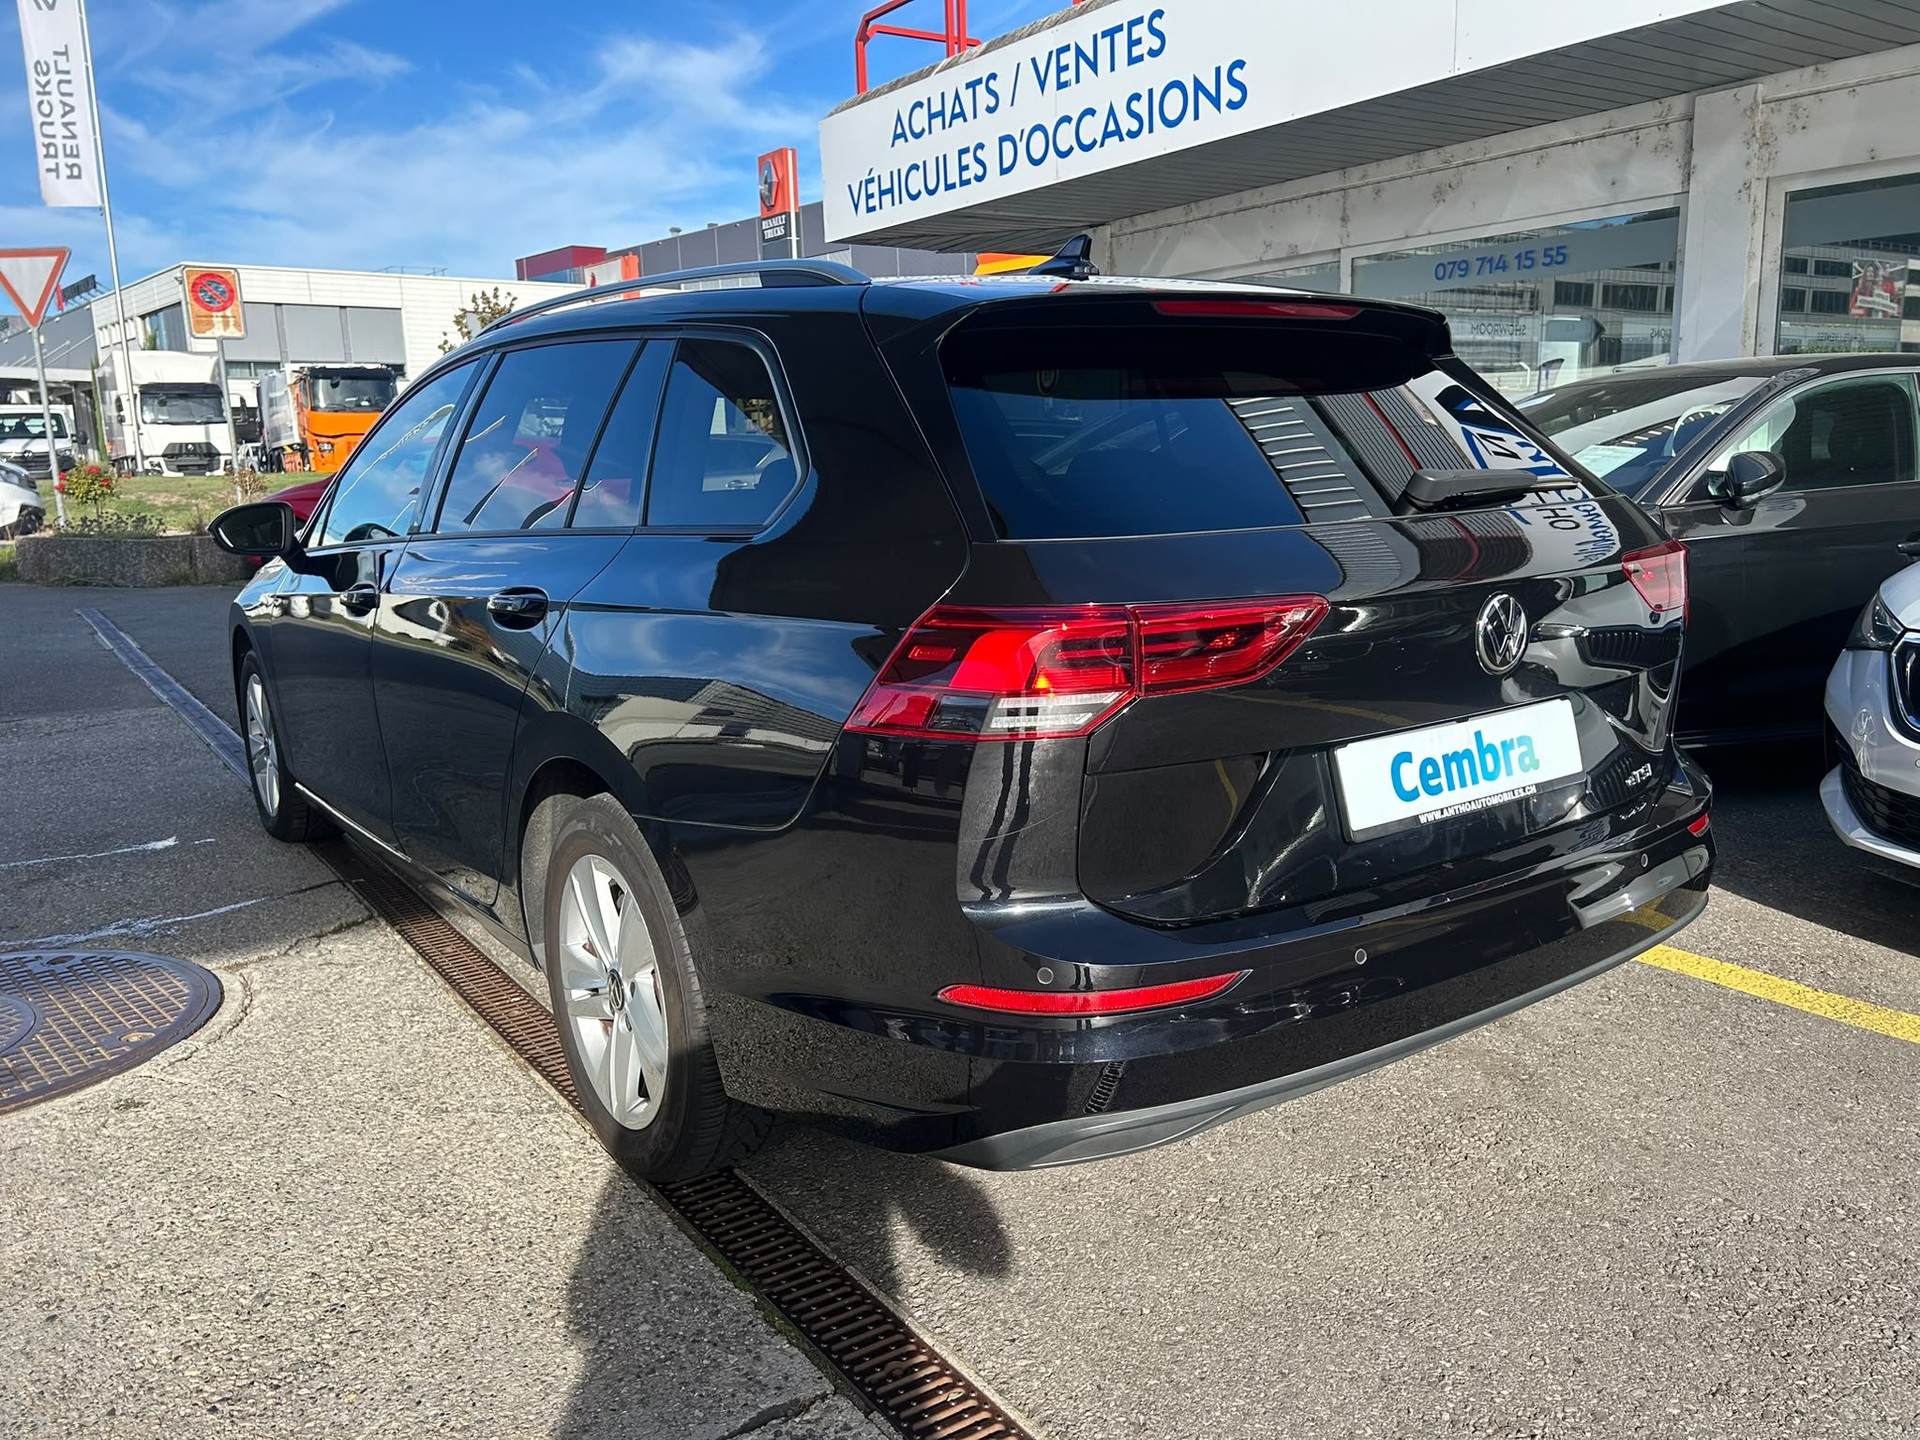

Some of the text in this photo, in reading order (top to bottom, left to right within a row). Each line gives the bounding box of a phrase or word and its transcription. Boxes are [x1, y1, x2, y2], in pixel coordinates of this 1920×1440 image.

[891, 72, 1000, 148] ACHATS
[1030, 8, 1167, 96] VENTES
[847, 58, 1249, 217] VÉHICULES D'OCCASIONS
[762, 214, 786, 230] RENAULT
[763, 226, 785, 240] TRUCKS
[1434, 245, 1568, 281] 079 714 15 55
[1390, 729, 1541, 803] Cembra
[1418, 784, 1538, 825] WWW.ANTHOAUTOMOBILES.CH
